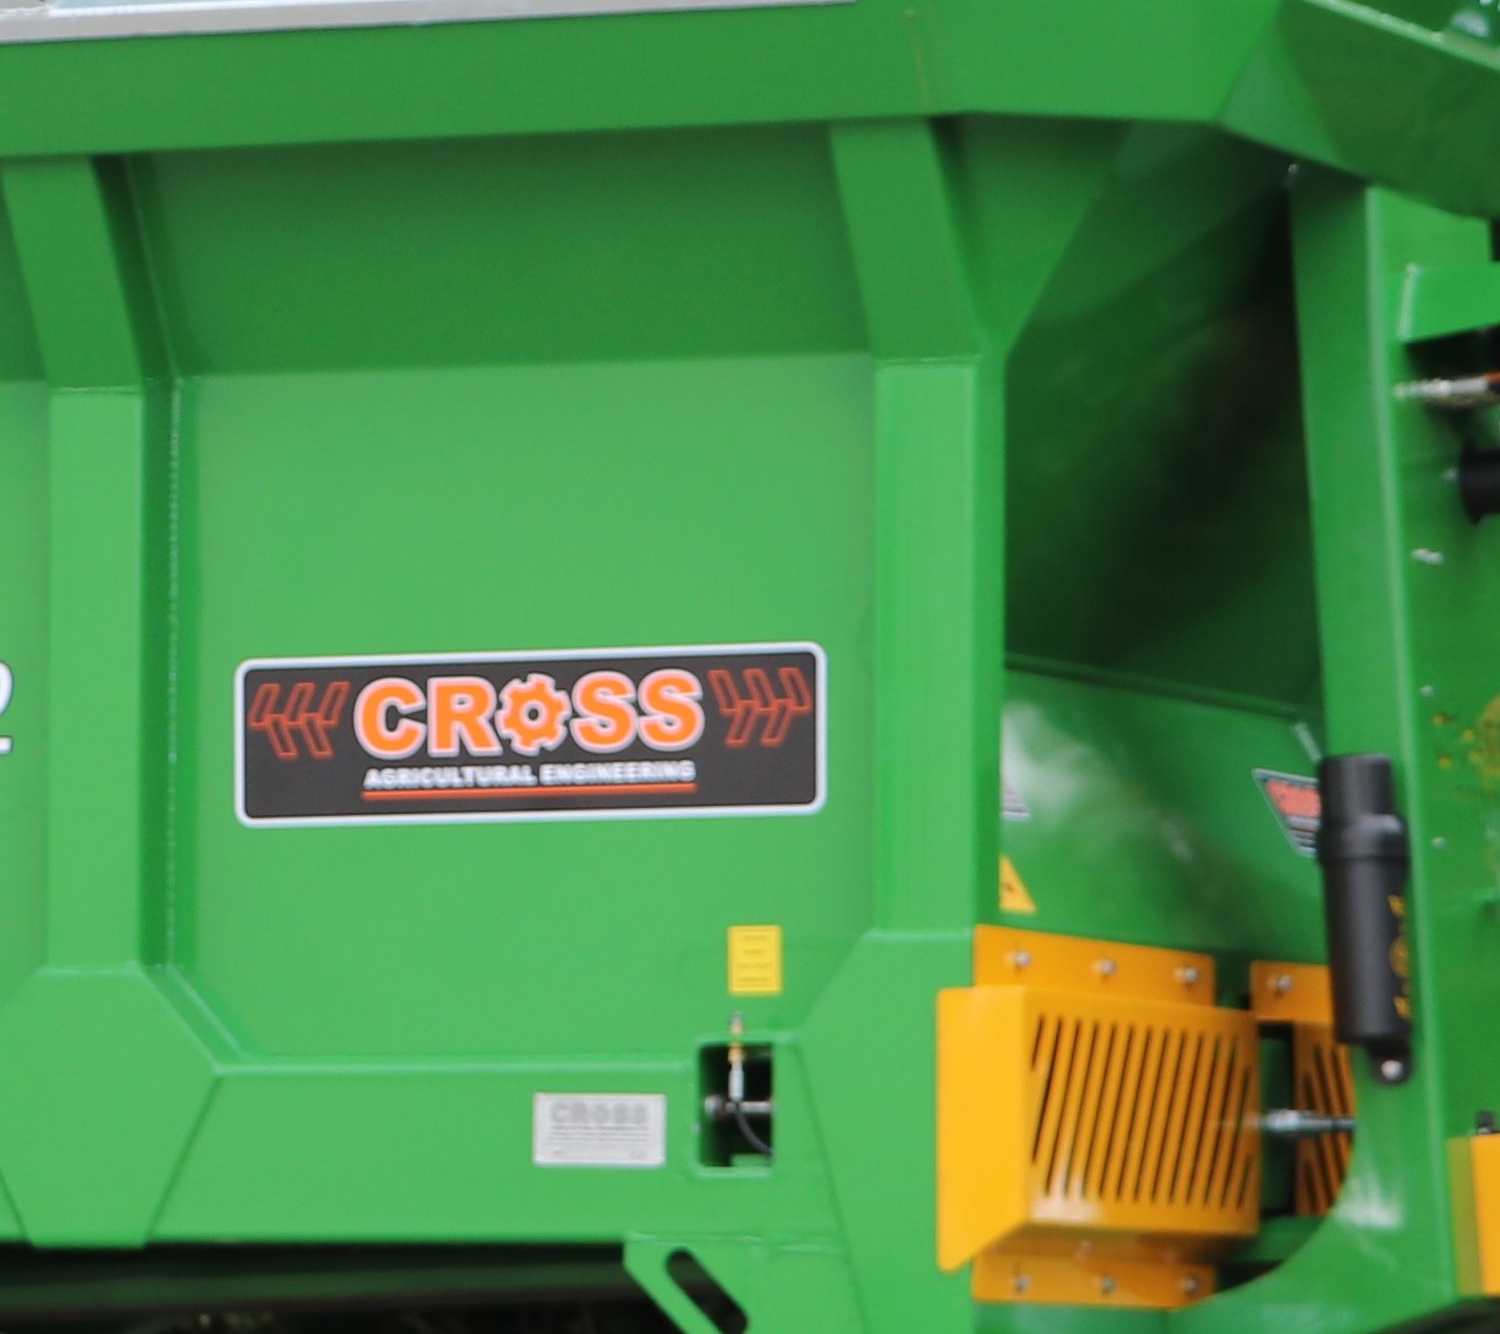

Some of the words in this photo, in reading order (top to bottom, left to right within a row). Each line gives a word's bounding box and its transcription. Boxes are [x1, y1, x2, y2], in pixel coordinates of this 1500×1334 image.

[354, 668, 704, 758] CROSS
[362, 764, 538, 791] AGRICULTURAL
[539, 759, 697, 787] ENGINEERING
